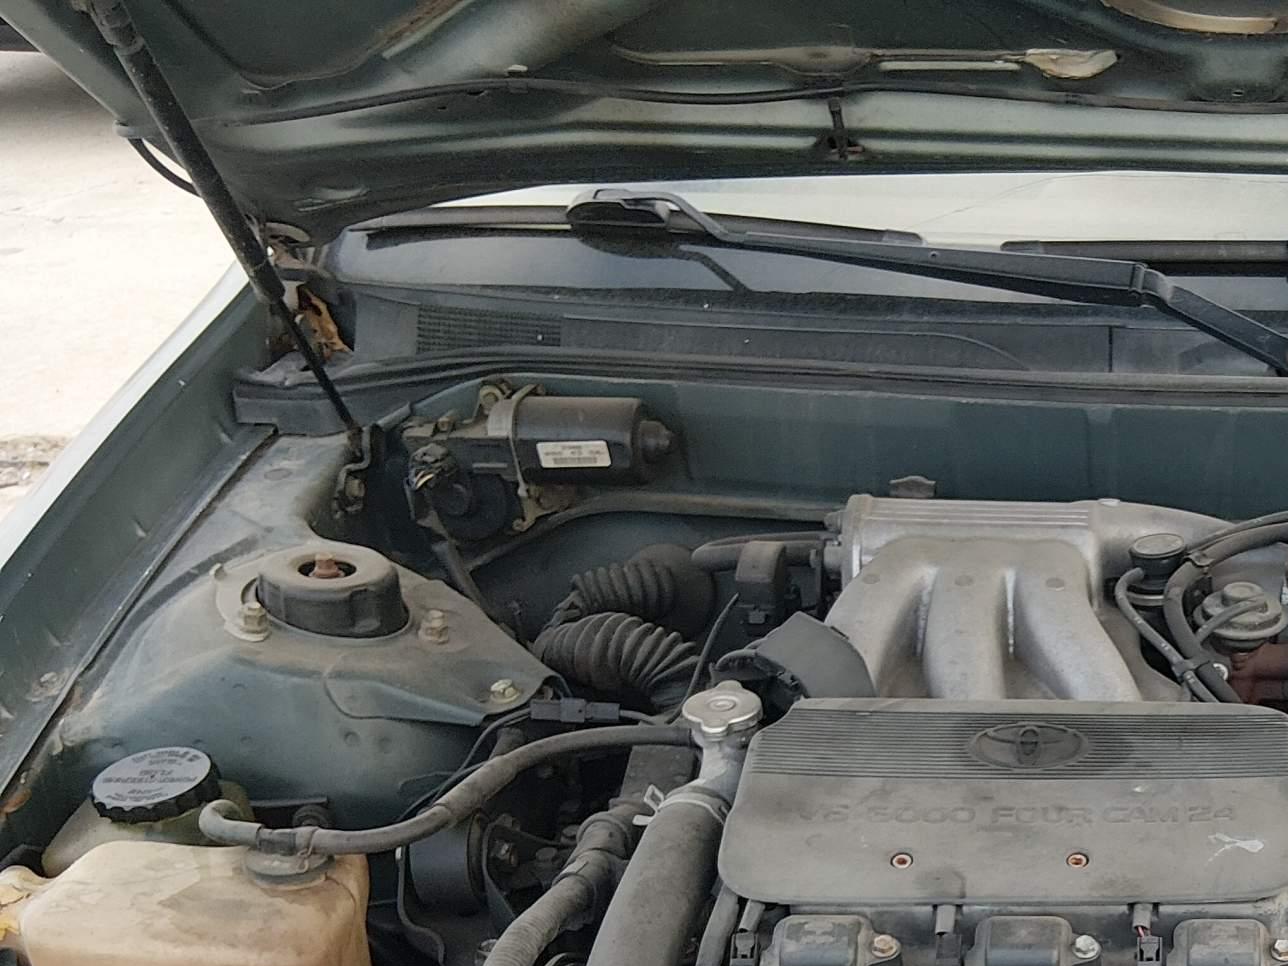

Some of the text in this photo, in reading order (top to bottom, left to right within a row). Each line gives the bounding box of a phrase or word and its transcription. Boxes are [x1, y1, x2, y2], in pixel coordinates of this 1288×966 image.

[990, 806, 1094, 824] FOUR
[1101, 806, 1179, 823] CAM
[1187, 805, 1238, 823] 24
